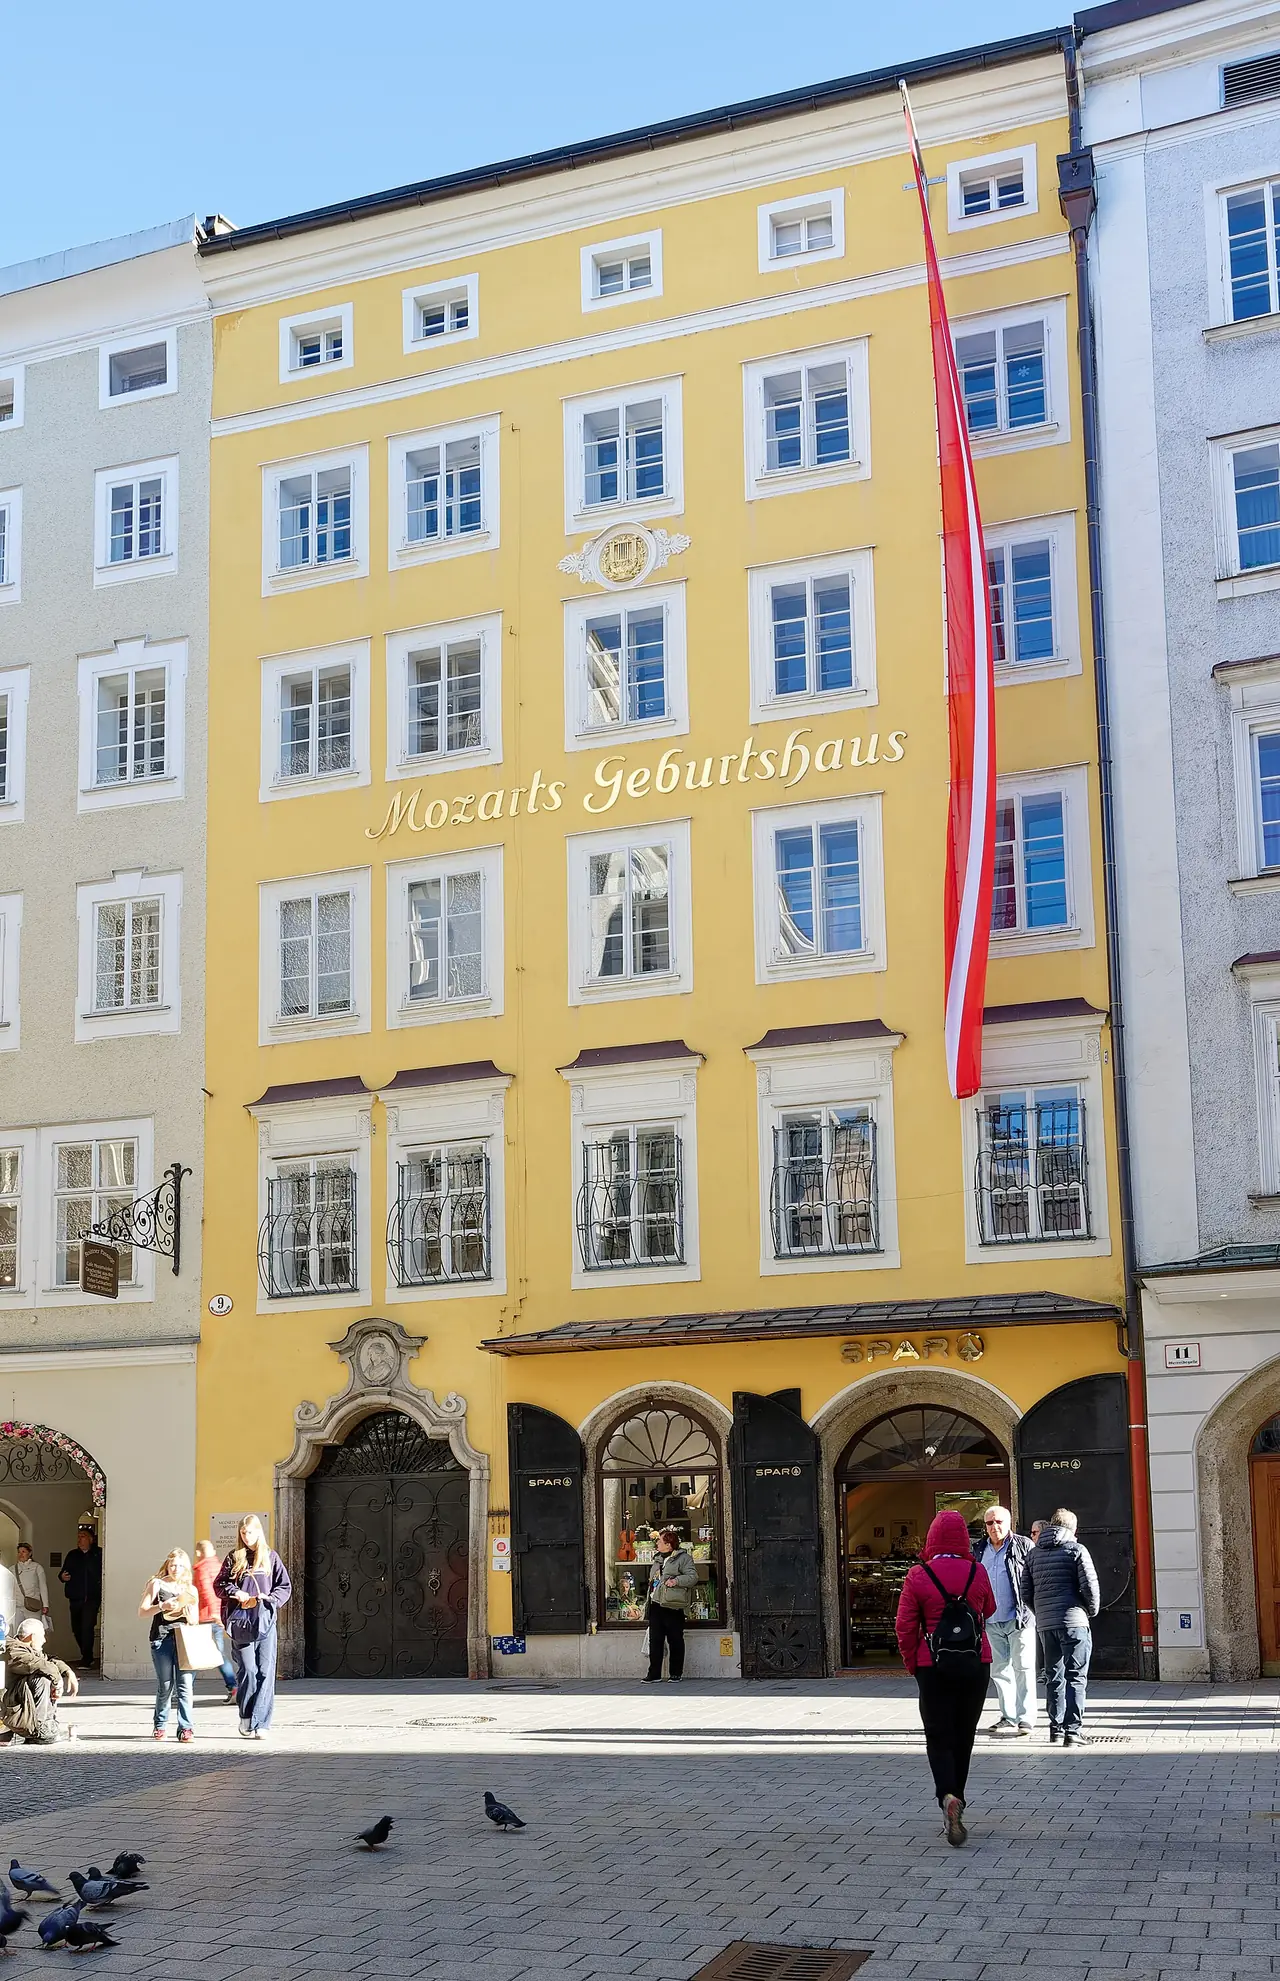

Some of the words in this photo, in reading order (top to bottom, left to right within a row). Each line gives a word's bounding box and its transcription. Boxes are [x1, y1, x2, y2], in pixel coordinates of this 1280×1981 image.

[364, 768, 566, 839] Mozarts
[583, 727, 908, 814] Geburtshaus
[217, 1296, 225, 1310] 9
[840, 1338, 949, 1365] SPAR
[1173, 1346, 1192, 1359] 11
[1033, 1461, 1070, 1470] SPAR
[755, 1468, 791, 1477] SPAR
[528, 1478, 562, 1487] SPAR
